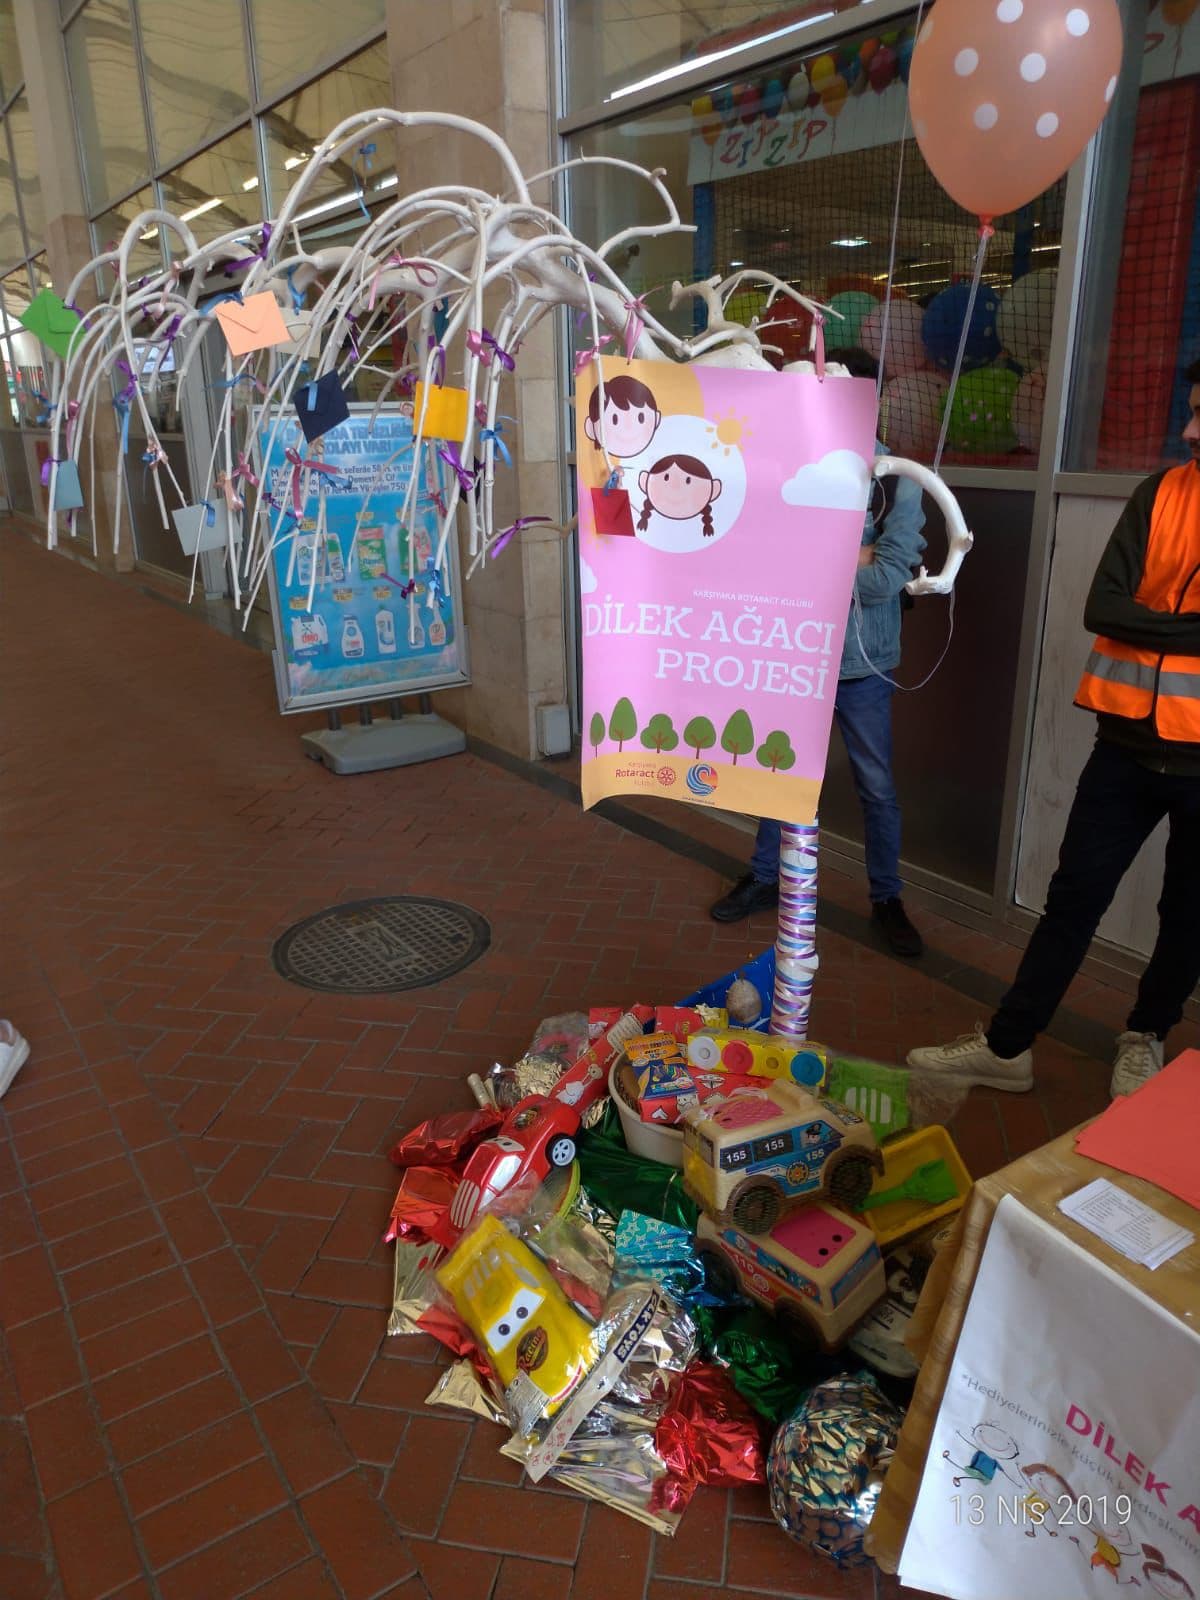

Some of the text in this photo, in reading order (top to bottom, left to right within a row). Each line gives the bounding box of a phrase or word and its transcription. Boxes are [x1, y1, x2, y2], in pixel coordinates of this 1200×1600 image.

[584, 594, 837, 656] DİLEK AĞACI
[655, 648, 830, 701] PROJESİ
[615, 768, 655, 779] Rotaract
[726, 1139, 785, 1164] 155 155
[805, 1148, 825, 1162] 155
[619, 1323, 645, 1360] TOYS
[1065, 1404, 1172, 1509] DİLEK
